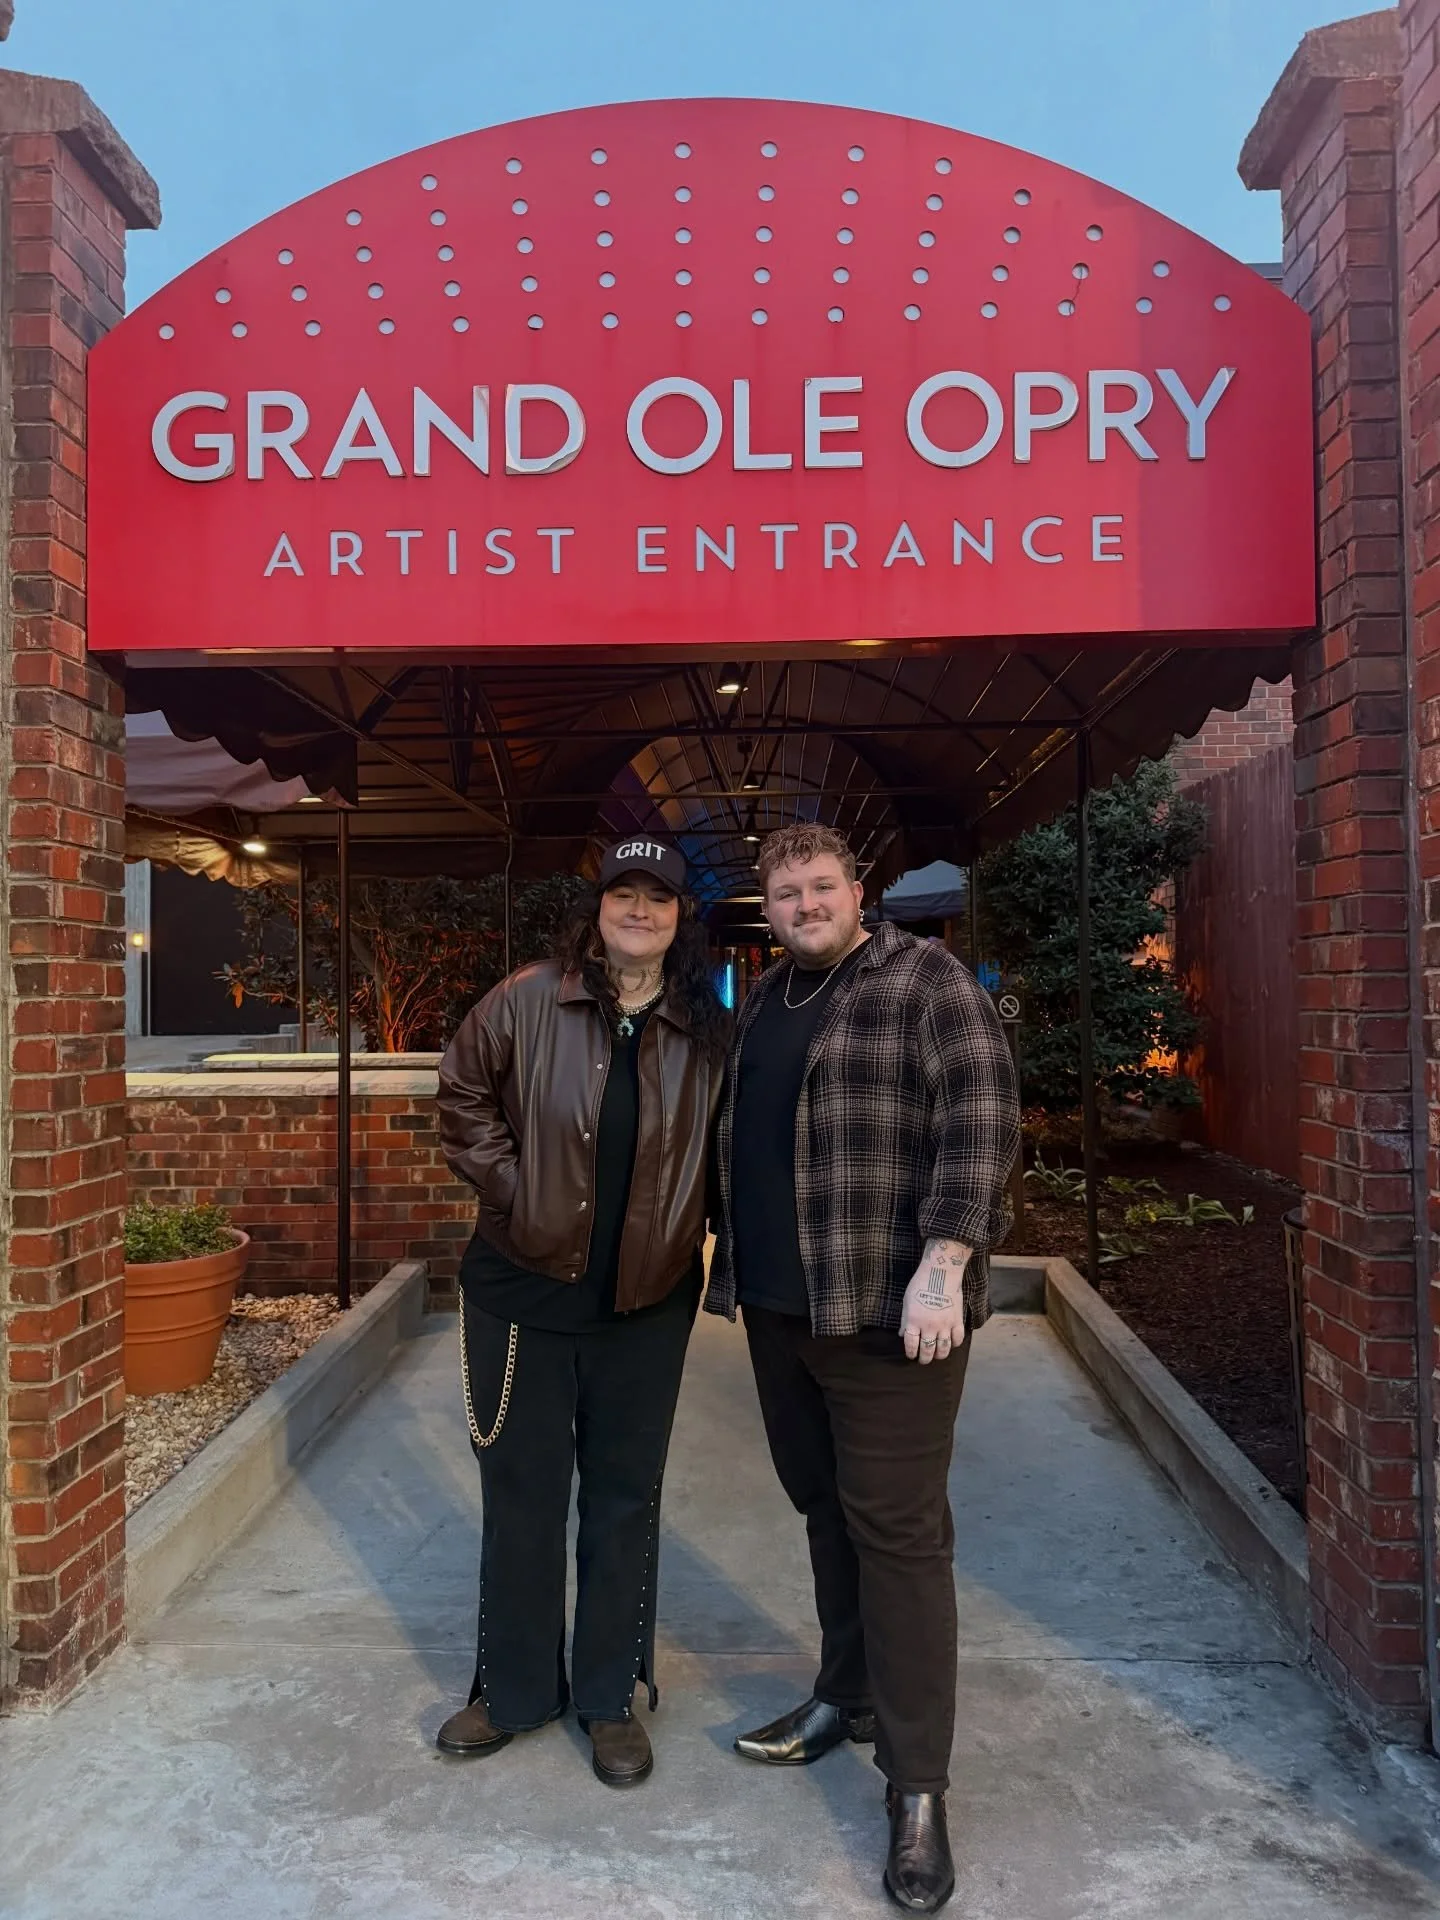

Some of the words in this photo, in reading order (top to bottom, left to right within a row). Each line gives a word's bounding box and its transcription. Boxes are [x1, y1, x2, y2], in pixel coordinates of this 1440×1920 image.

[151, 383, 587, 483] GRAND
[626, 376, 864, 475] OLE
[905, 366, 1238, 469] OPRY
[264, 528, 575, 577] ARTIST
[637, 515, 1125, 573] ENTRANCE
[615, 842, 667, 861] GRIT
